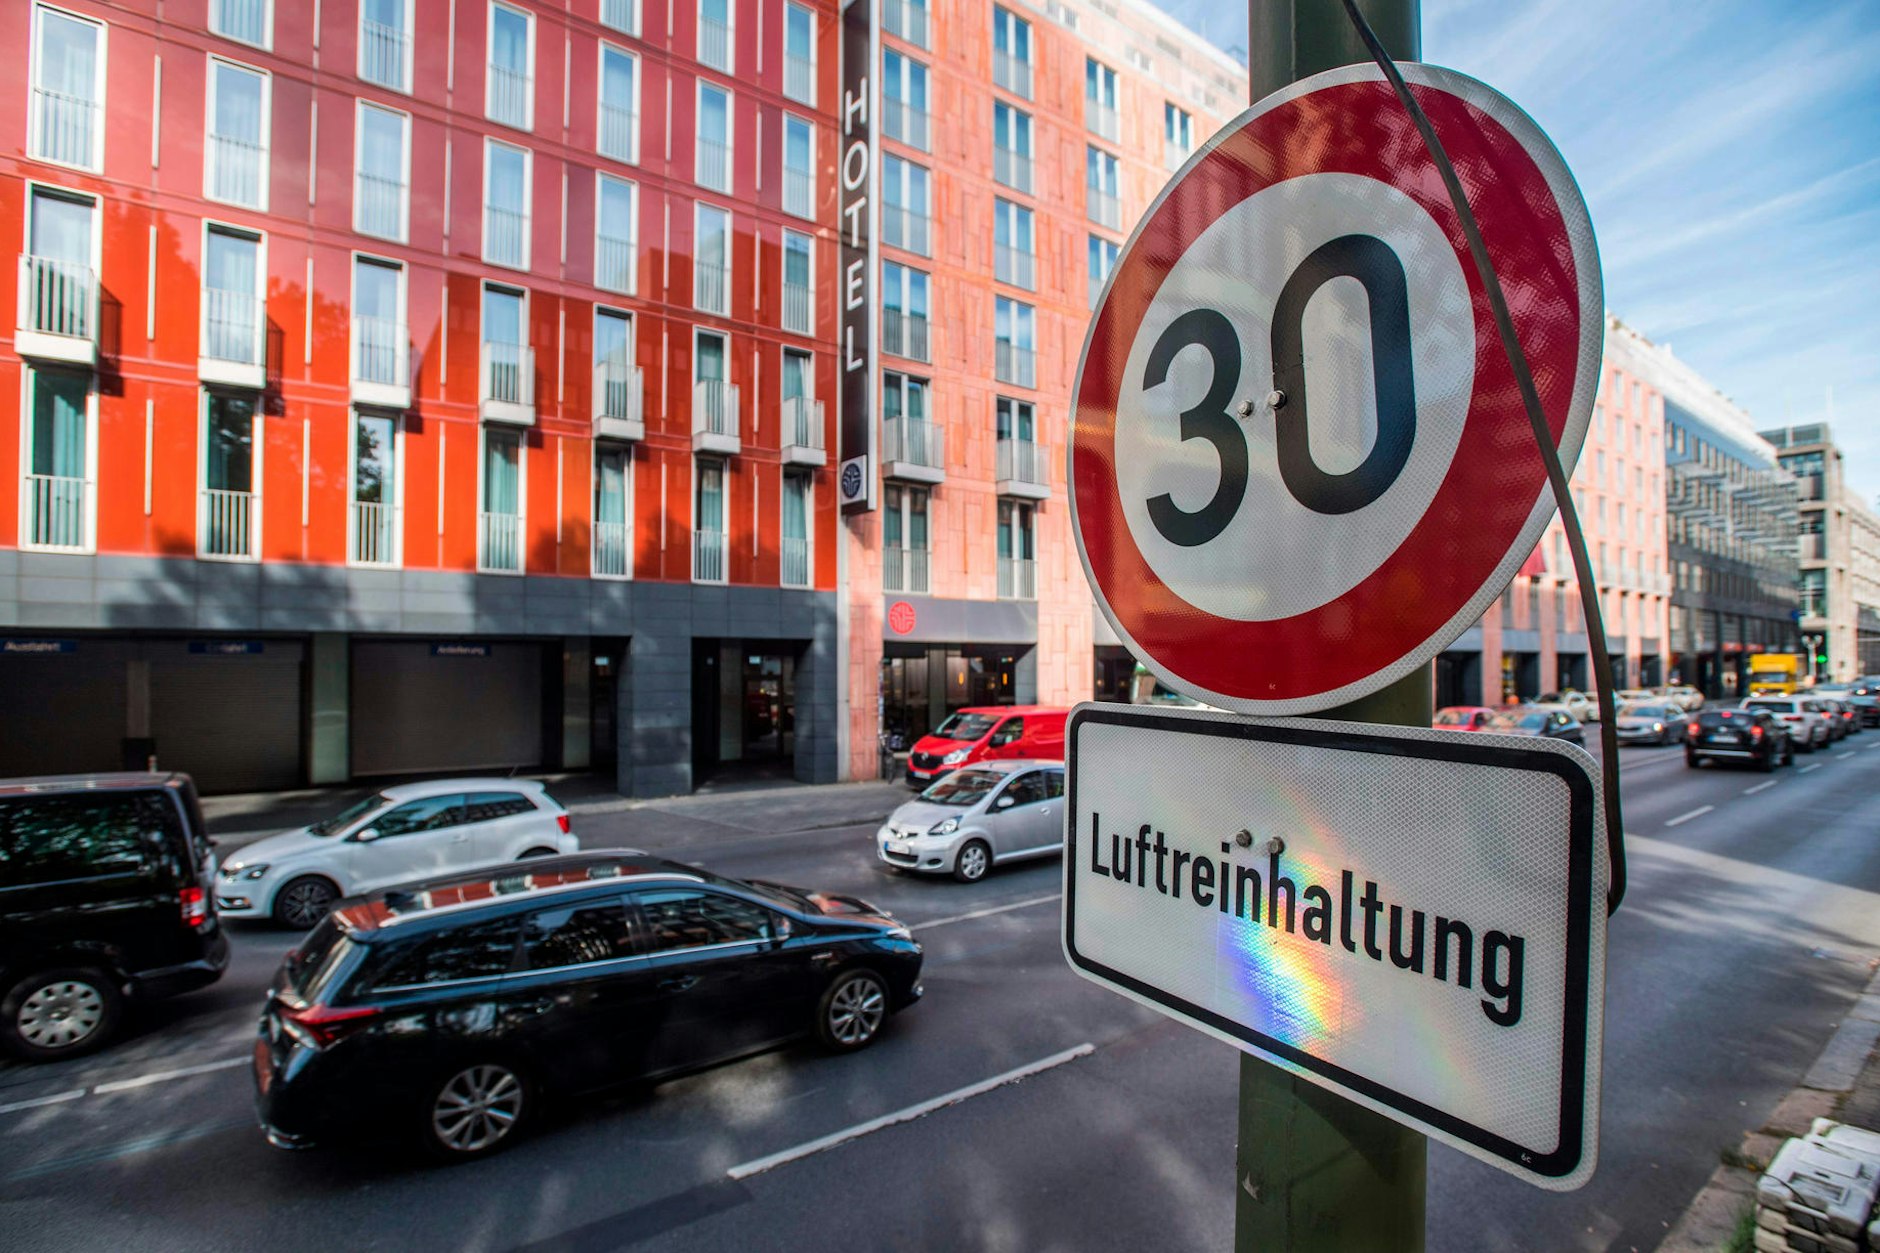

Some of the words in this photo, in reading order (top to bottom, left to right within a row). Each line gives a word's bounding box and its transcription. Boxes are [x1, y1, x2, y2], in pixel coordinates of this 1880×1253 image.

[843, 76, 868, 372] HOTEL
[1142, 233, 1417, 547] 30
[1091, 811, 1525, 1027] Luftreinhaltung
